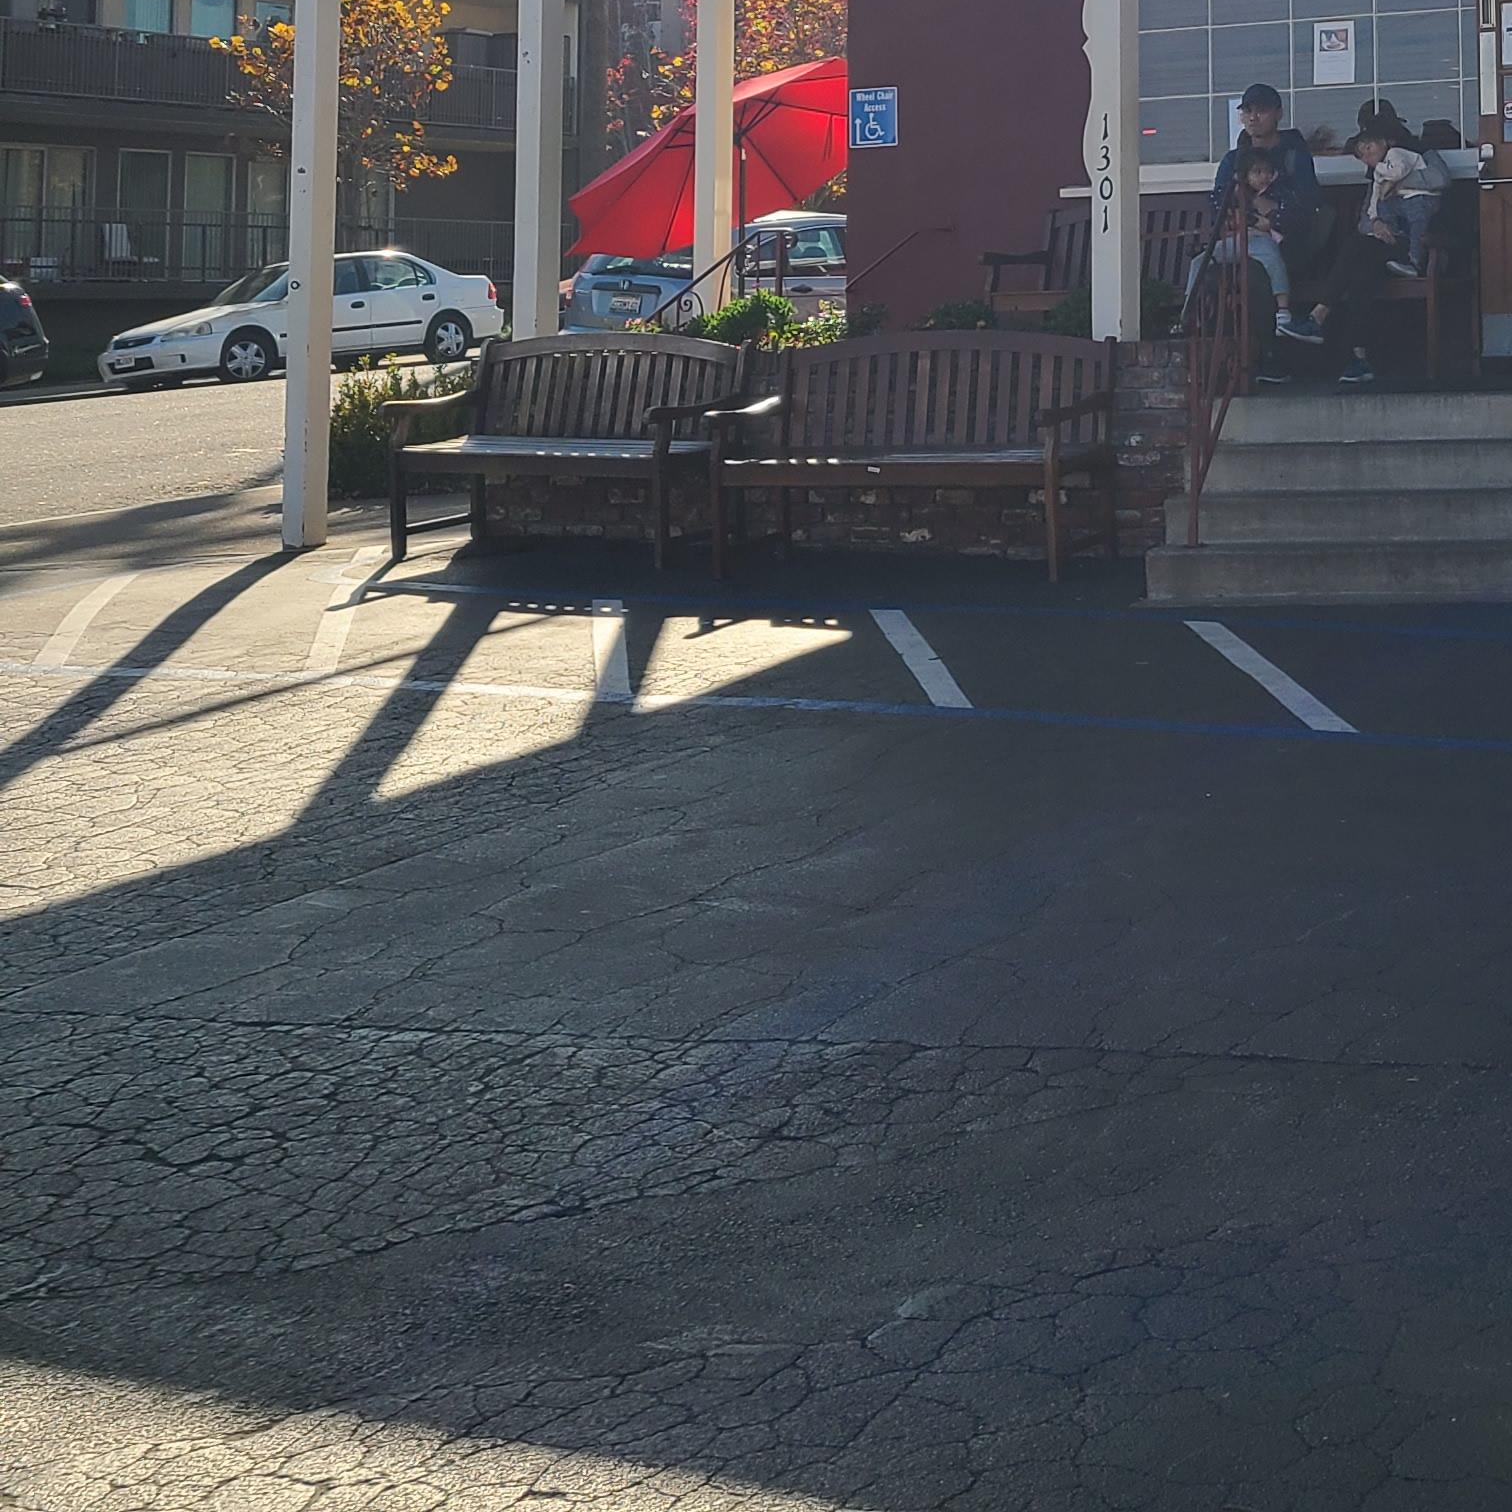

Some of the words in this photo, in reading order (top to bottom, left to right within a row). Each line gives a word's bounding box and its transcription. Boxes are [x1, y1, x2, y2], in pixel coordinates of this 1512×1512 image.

[856, 92, 875, 101] Wheel
[864, 103, 886, 112] Access
[1096, 112, 1114, 234] 1301
